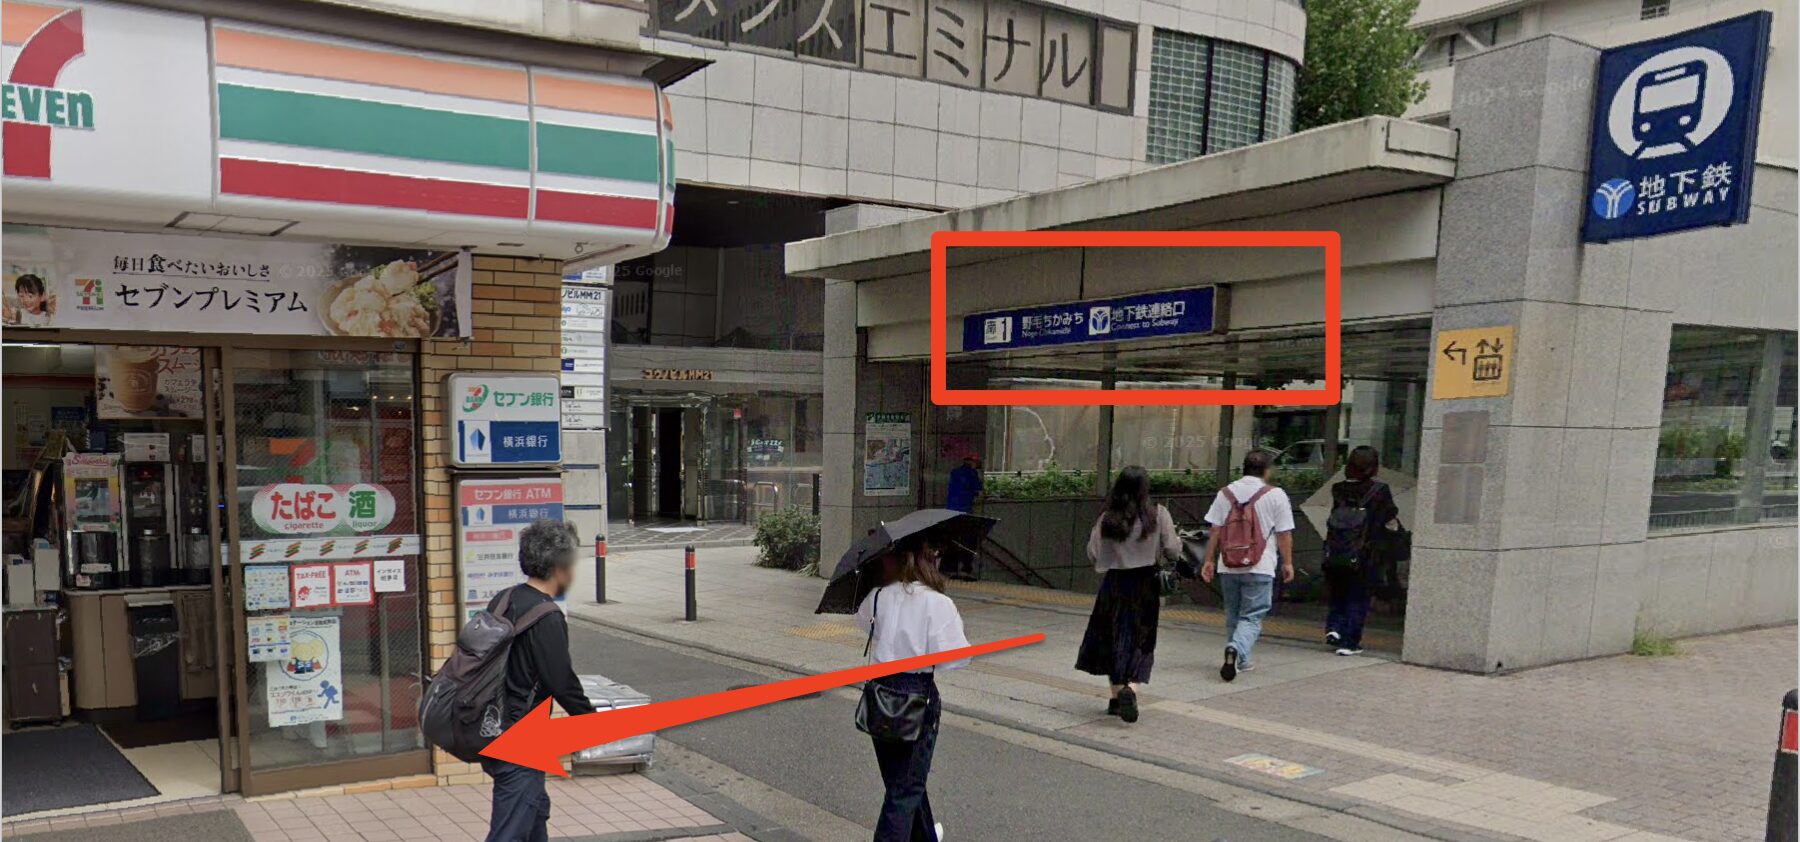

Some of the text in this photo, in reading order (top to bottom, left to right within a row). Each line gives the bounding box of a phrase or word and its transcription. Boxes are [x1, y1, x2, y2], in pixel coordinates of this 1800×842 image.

[1638, 162, 1732, 199] 地下鉄
[1638, 188, 1729, 216] SUBWAY
[114, 254, 270, 278] 毎日食べたいおいしさ
[115, 283, 309, 313] セブンプレミアム
[1111, 301, 1185, 321] 地下鉄連絡口
[1022, 312, 1083, 331] 野毛ちかみち
[1152, 318, 1179, 328] Subway
[493, 391, 554, 407] セブン銀行
[503, 435, 548, 448] 横浜銀行
[475, 487, 552, 501] セブン銀行 ATM
[271, 490, 376, 520] たばこ 酒
[508, 508, 548, 519] 横浜銀行
[284, 521, 377, 530] cigarette liquor
[296, 571, 326, 579] TAX-FREE
[344, 569, 360, 577] ATM
